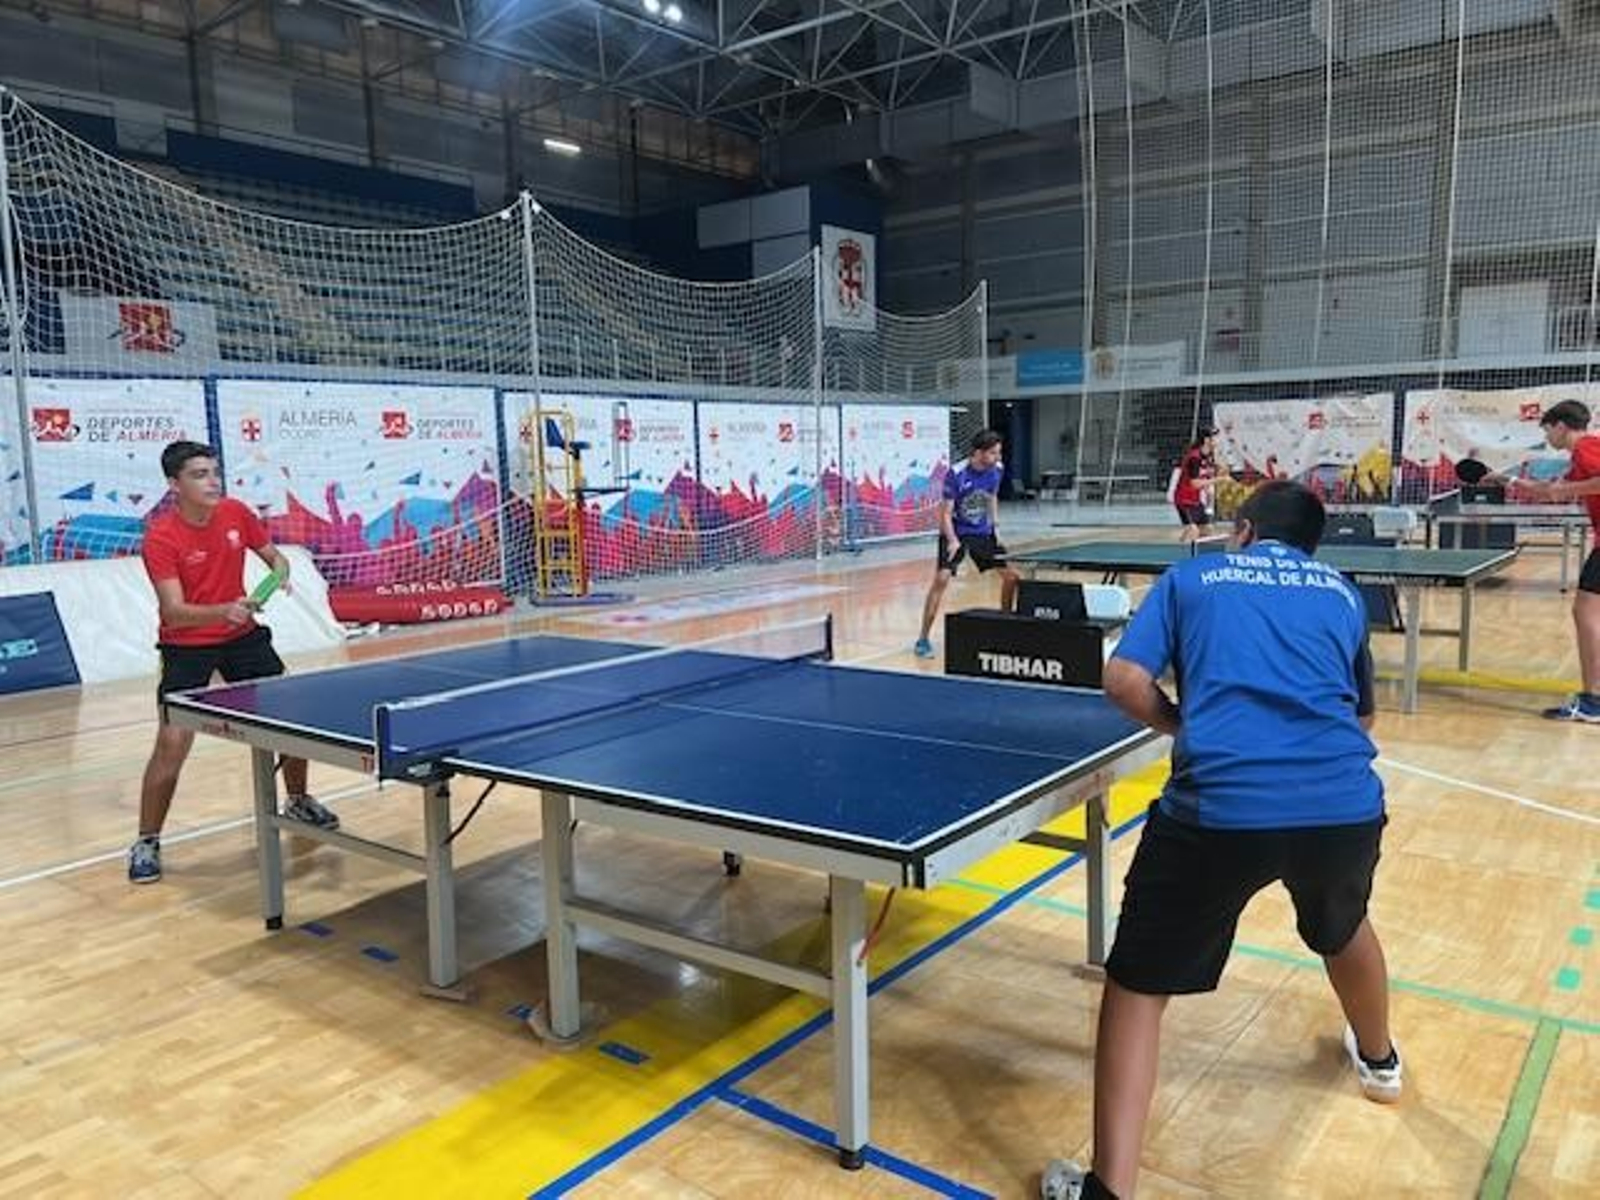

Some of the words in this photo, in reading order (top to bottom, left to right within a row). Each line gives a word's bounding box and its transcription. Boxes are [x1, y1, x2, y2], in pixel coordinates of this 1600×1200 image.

[86, 416, 176, 430] DEPORTES
[89, 431, 110, 442] DE
[1226, 554, 1272, 568] TENIS
[1276, 559, 1298, 570] DE
[1279, 571, 1302, 586] DE
[978, 651, 1063, 680] TIBHAR
